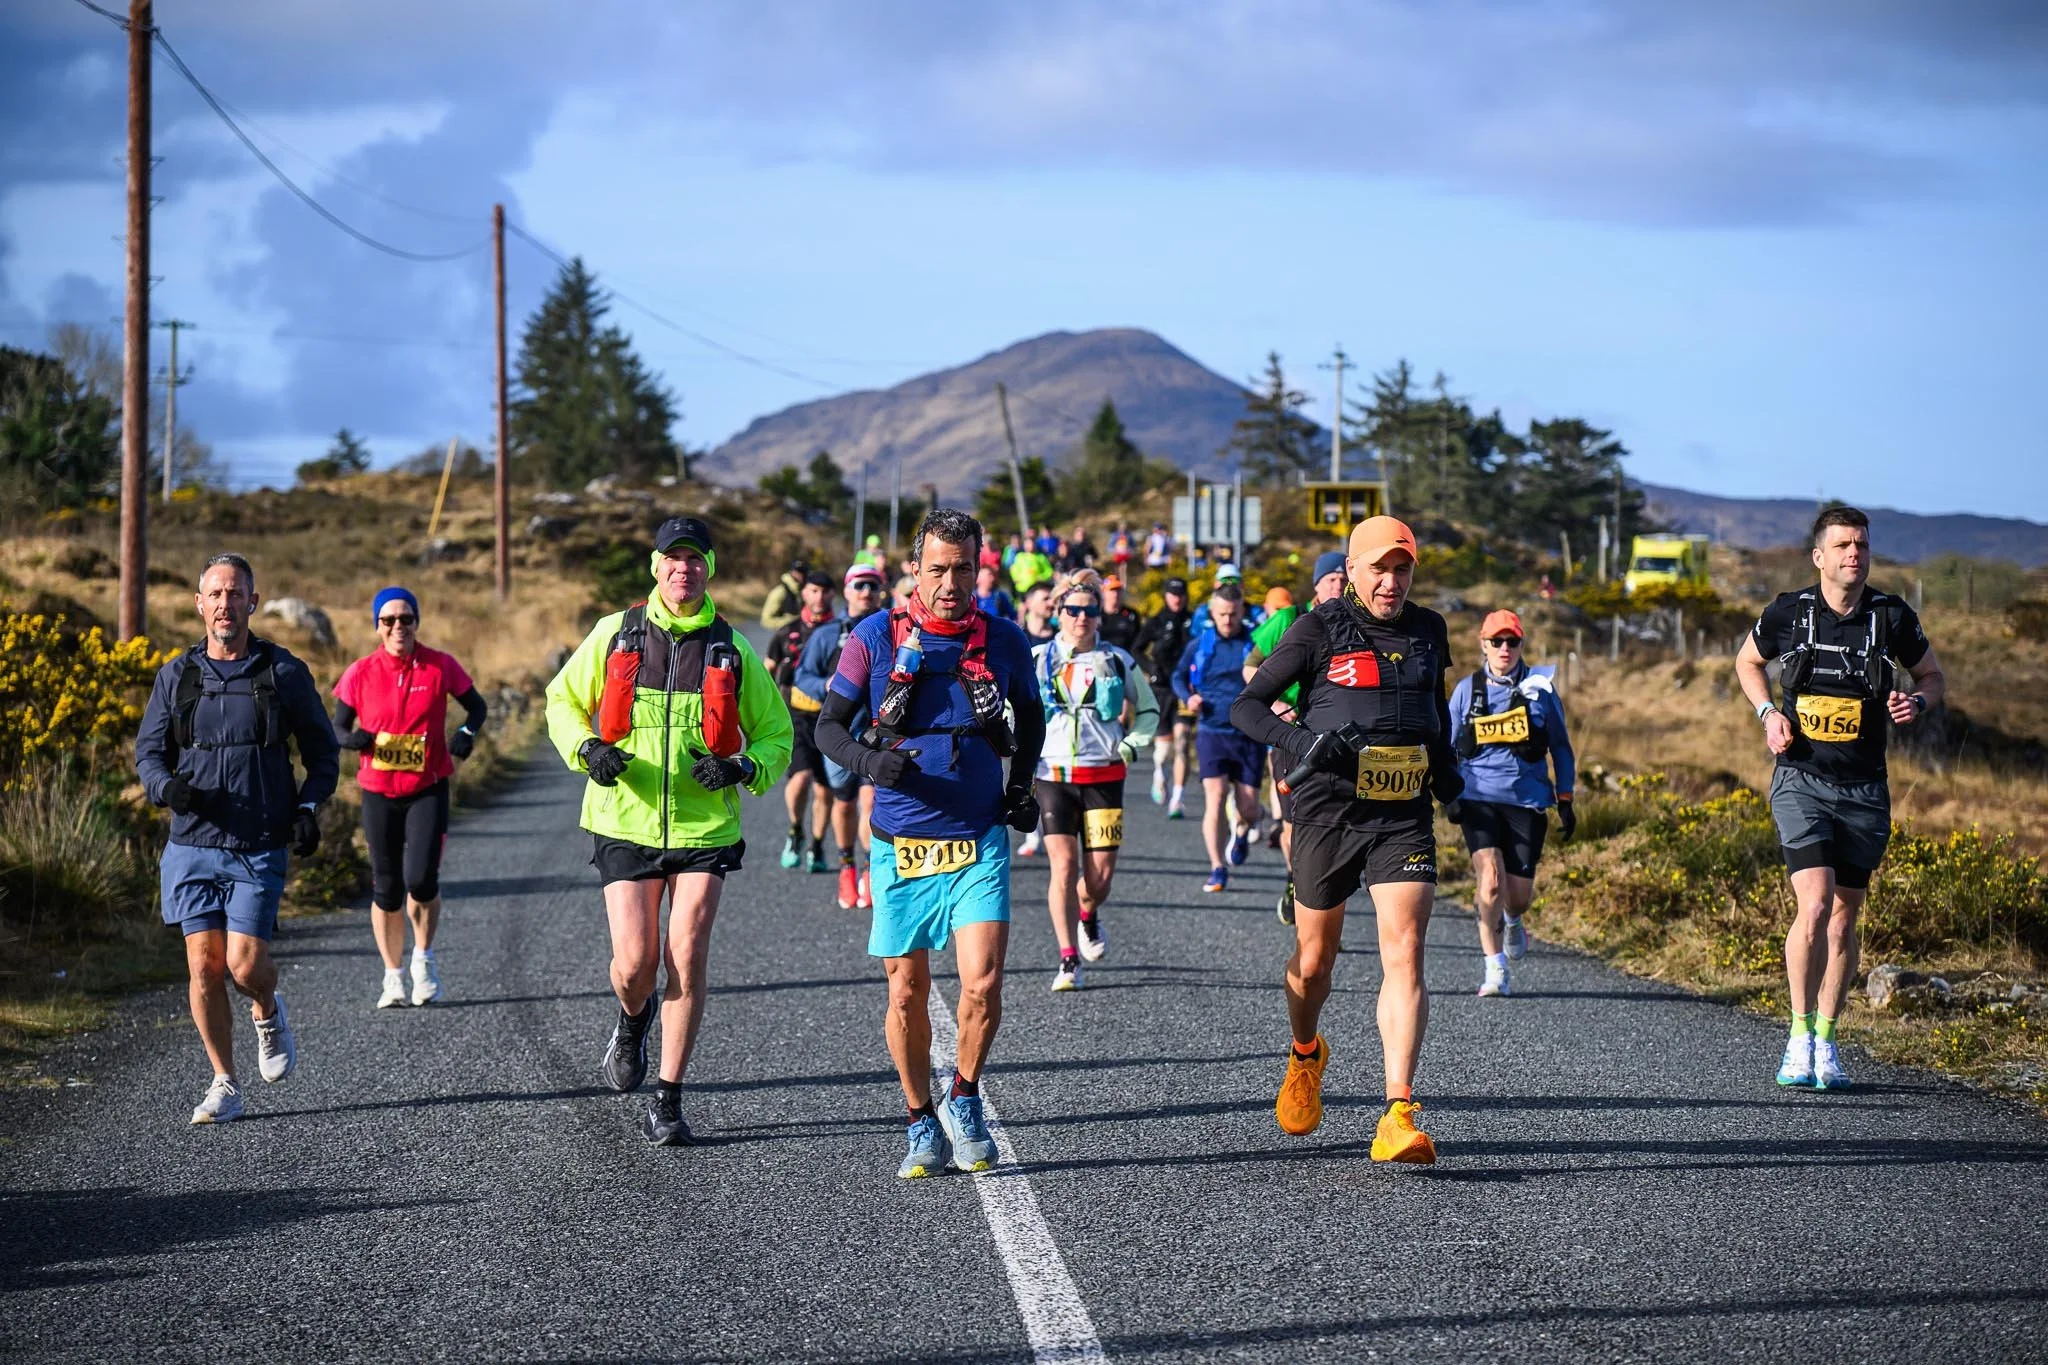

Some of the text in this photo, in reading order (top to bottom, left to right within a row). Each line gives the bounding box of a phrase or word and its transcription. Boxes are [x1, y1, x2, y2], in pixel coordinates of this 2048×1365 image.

[1478, 719, 1526, 737] 39133
[1800, 713, 1859, 734] 39156
[376, 748, 423, 765] 39138
[1359, 769, 1425, 793] 39018
[898, 840, 974, 871] 39019
